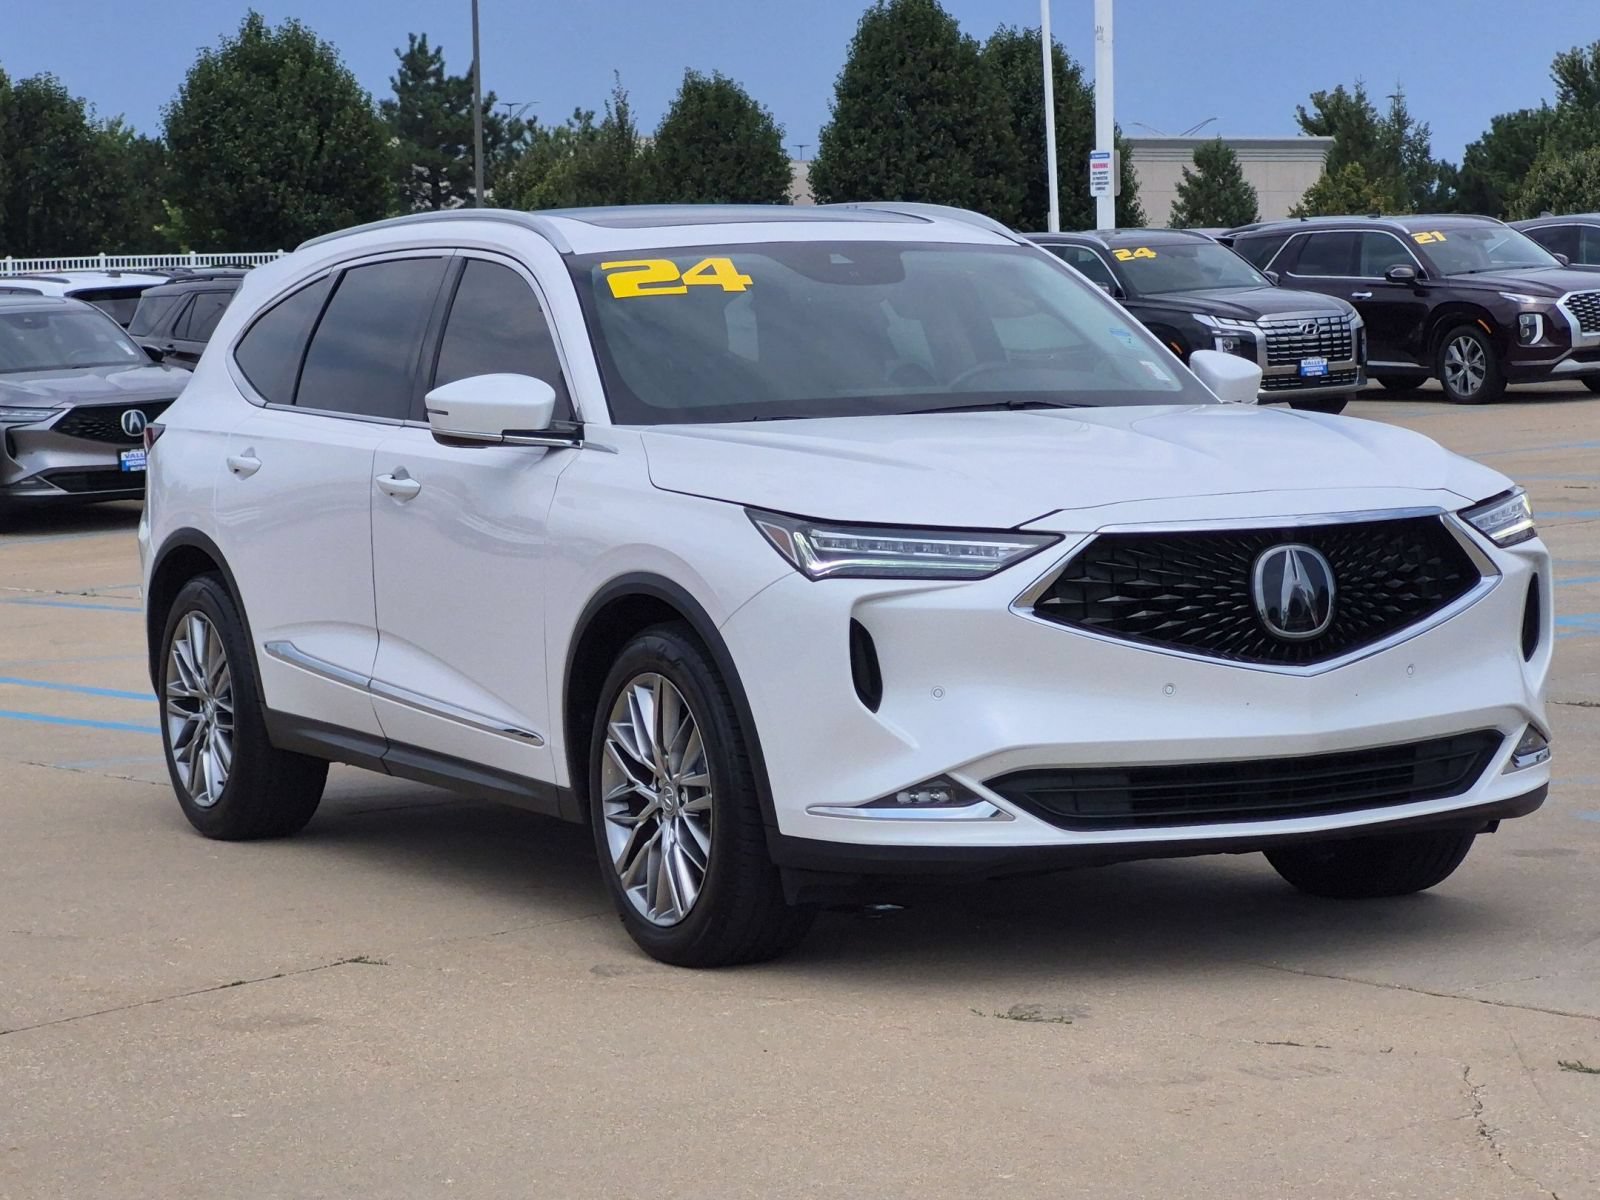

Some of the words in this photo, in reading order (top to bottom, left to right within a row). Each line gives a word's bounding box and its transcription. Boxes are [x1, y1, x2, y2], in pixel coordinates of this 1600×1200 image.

[1411, 231, 1447, 244] 21
[1112, 247, 1157, 261] 24
[600, 257, 754, 299] 24
